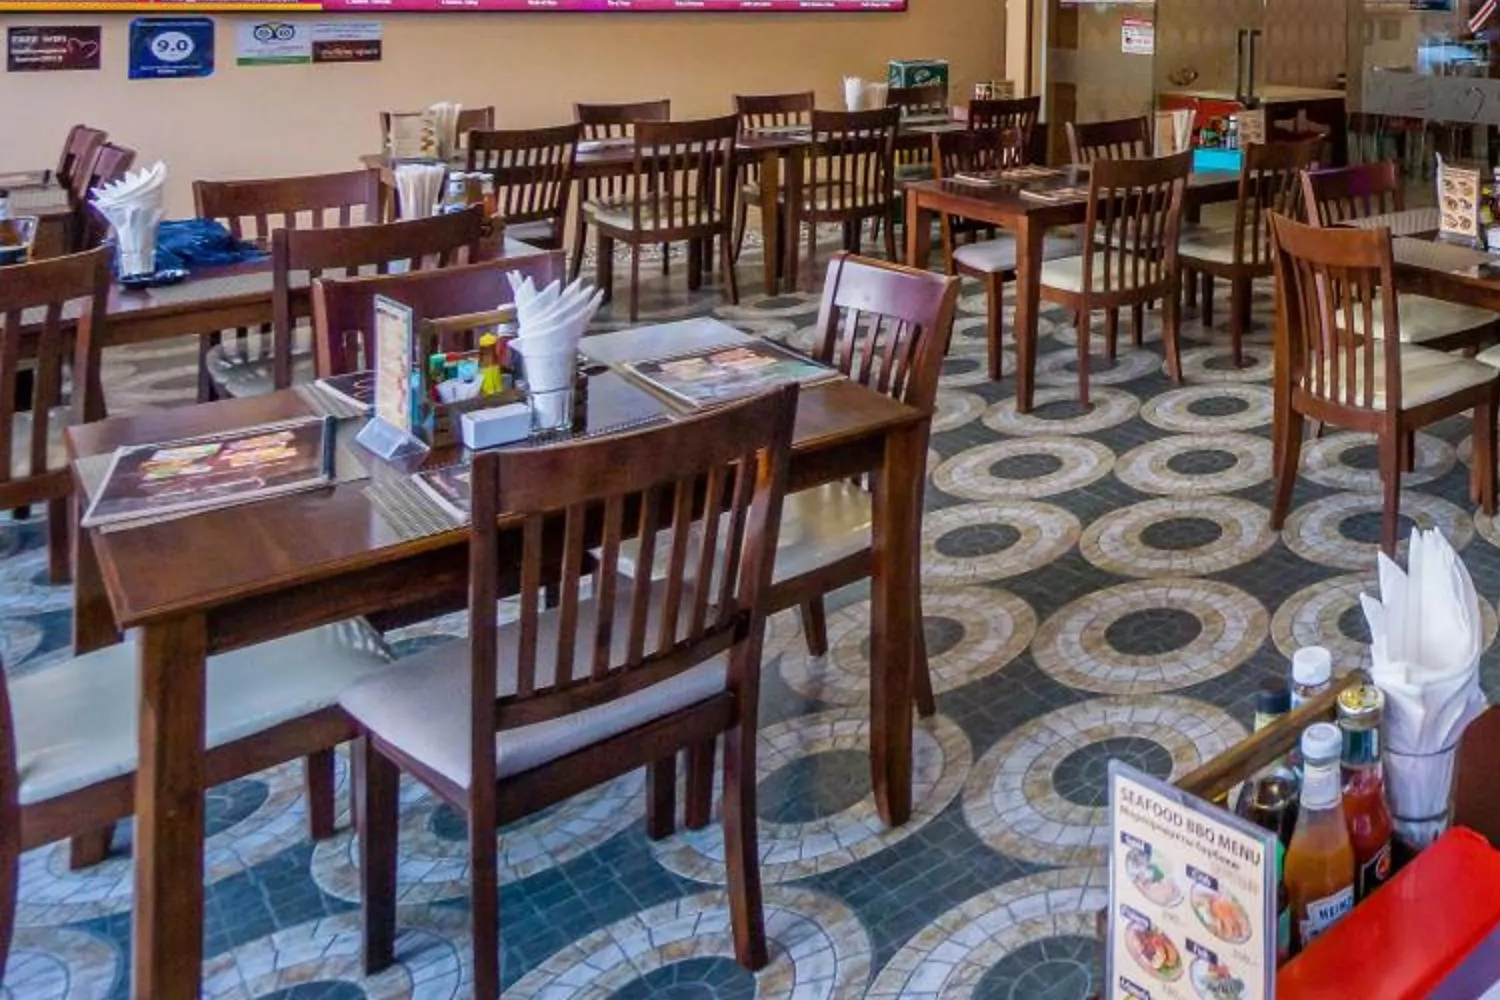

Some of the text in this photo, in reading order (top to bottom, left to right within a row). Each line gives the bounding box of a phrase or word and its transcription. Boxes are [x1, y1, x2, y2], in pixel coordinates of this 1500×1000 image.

[157, 39, 189, 52] 9.0
[1120, 786, 1261, 866] SEAFOOD BBQ MENU
